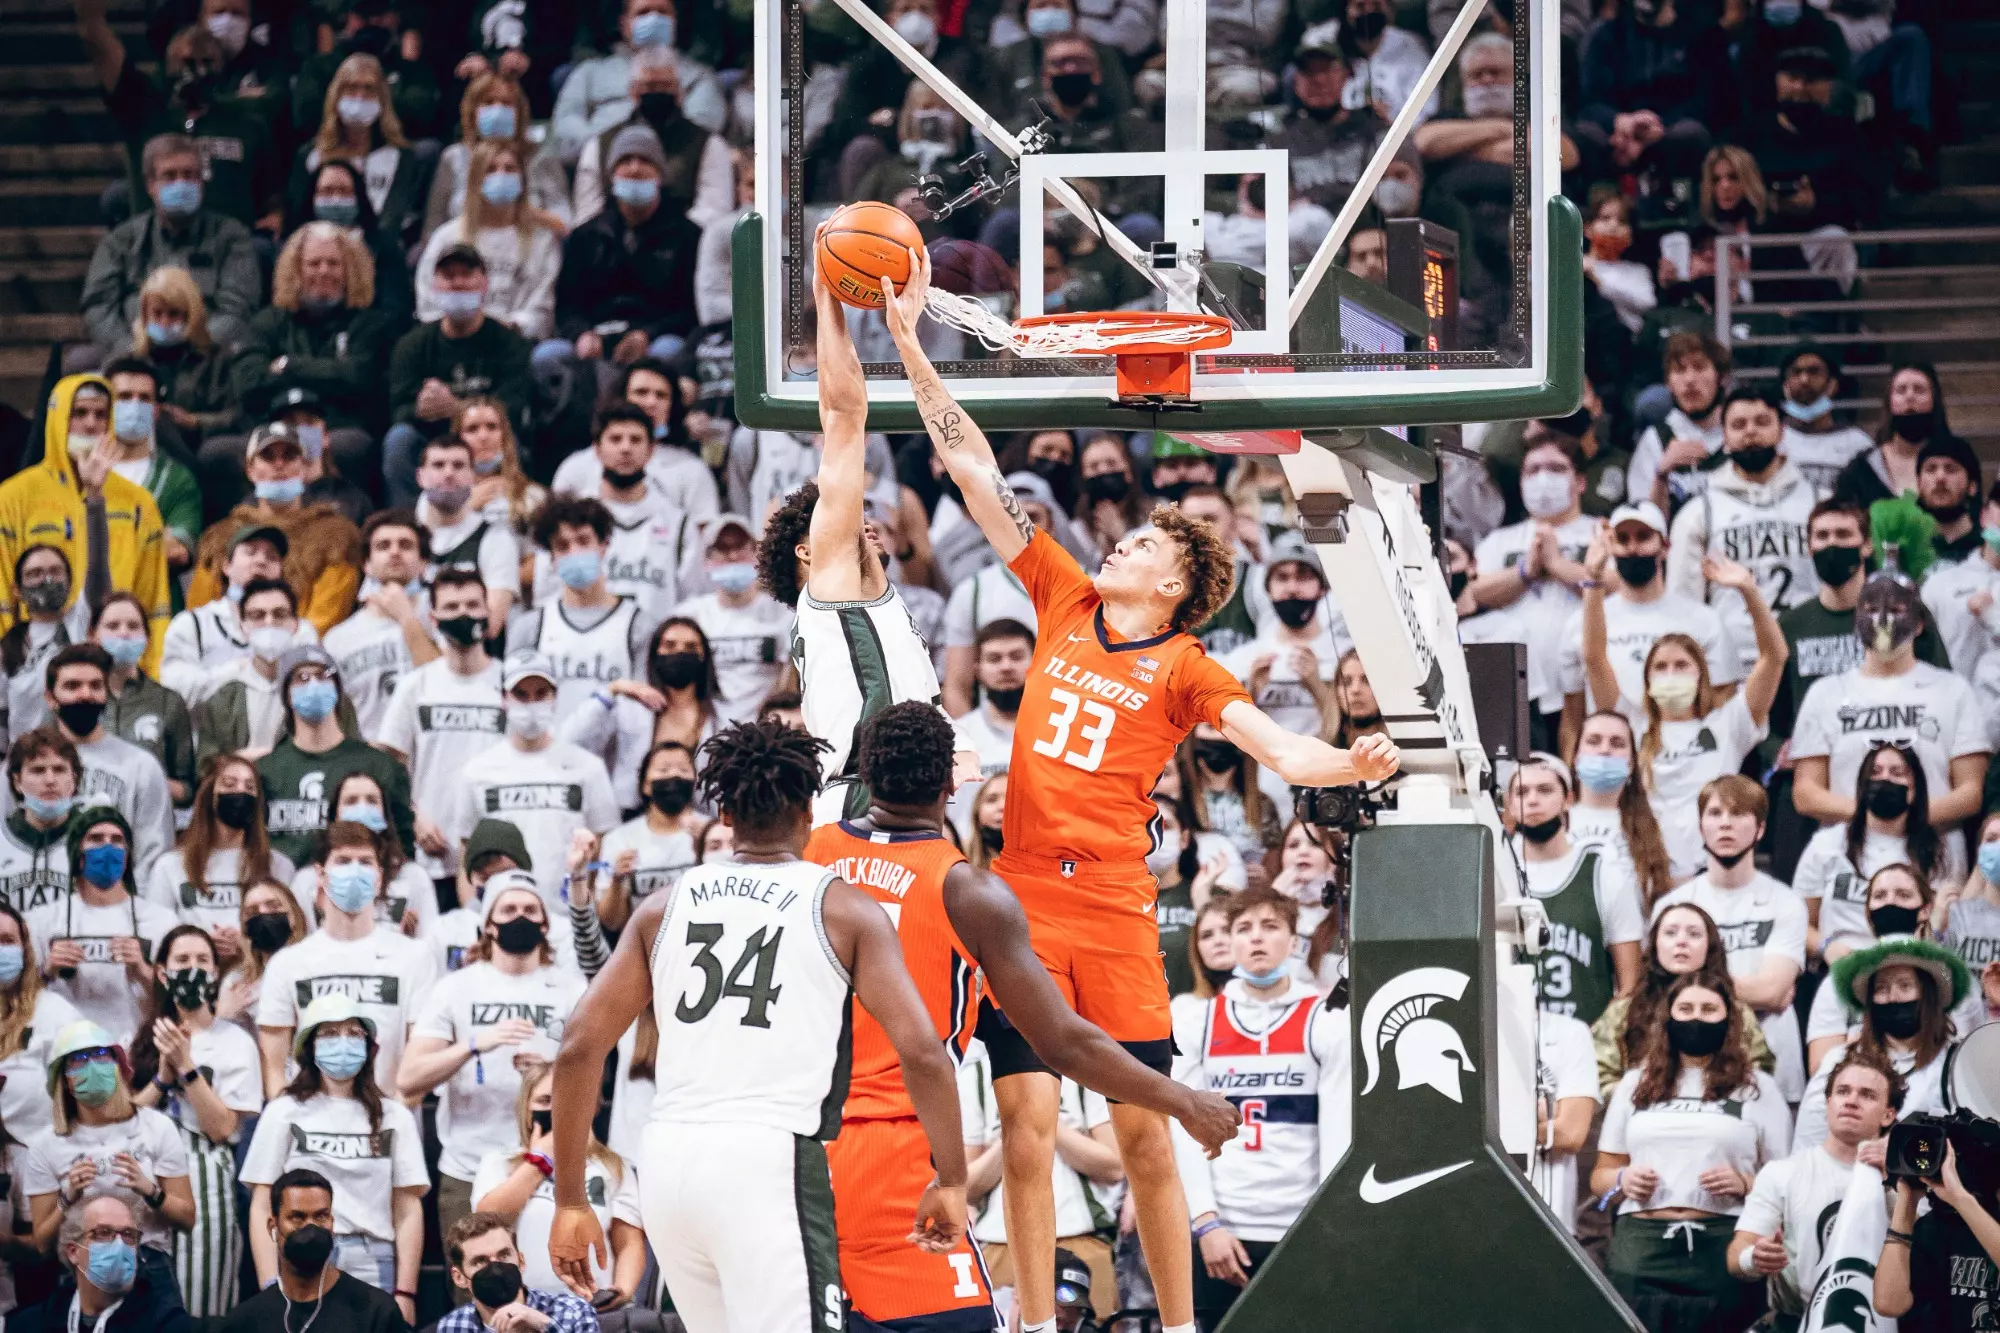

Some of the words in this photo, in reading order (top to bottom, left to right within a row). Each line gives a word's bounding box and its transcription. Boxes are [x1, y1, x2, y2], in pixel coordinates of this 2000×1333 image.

[1043, 655, 1149, 712] ILLINOIS
[1032, 687, 1116, 773] 33
[690, 876, 780, 907] MARBLE
[675, 920, 784, 1030] 34
[1210, 1063, 1307, 1089] wizards
[305, 1133, 374, 1159] IZZON
[948, 1253, 980, 1299] I
